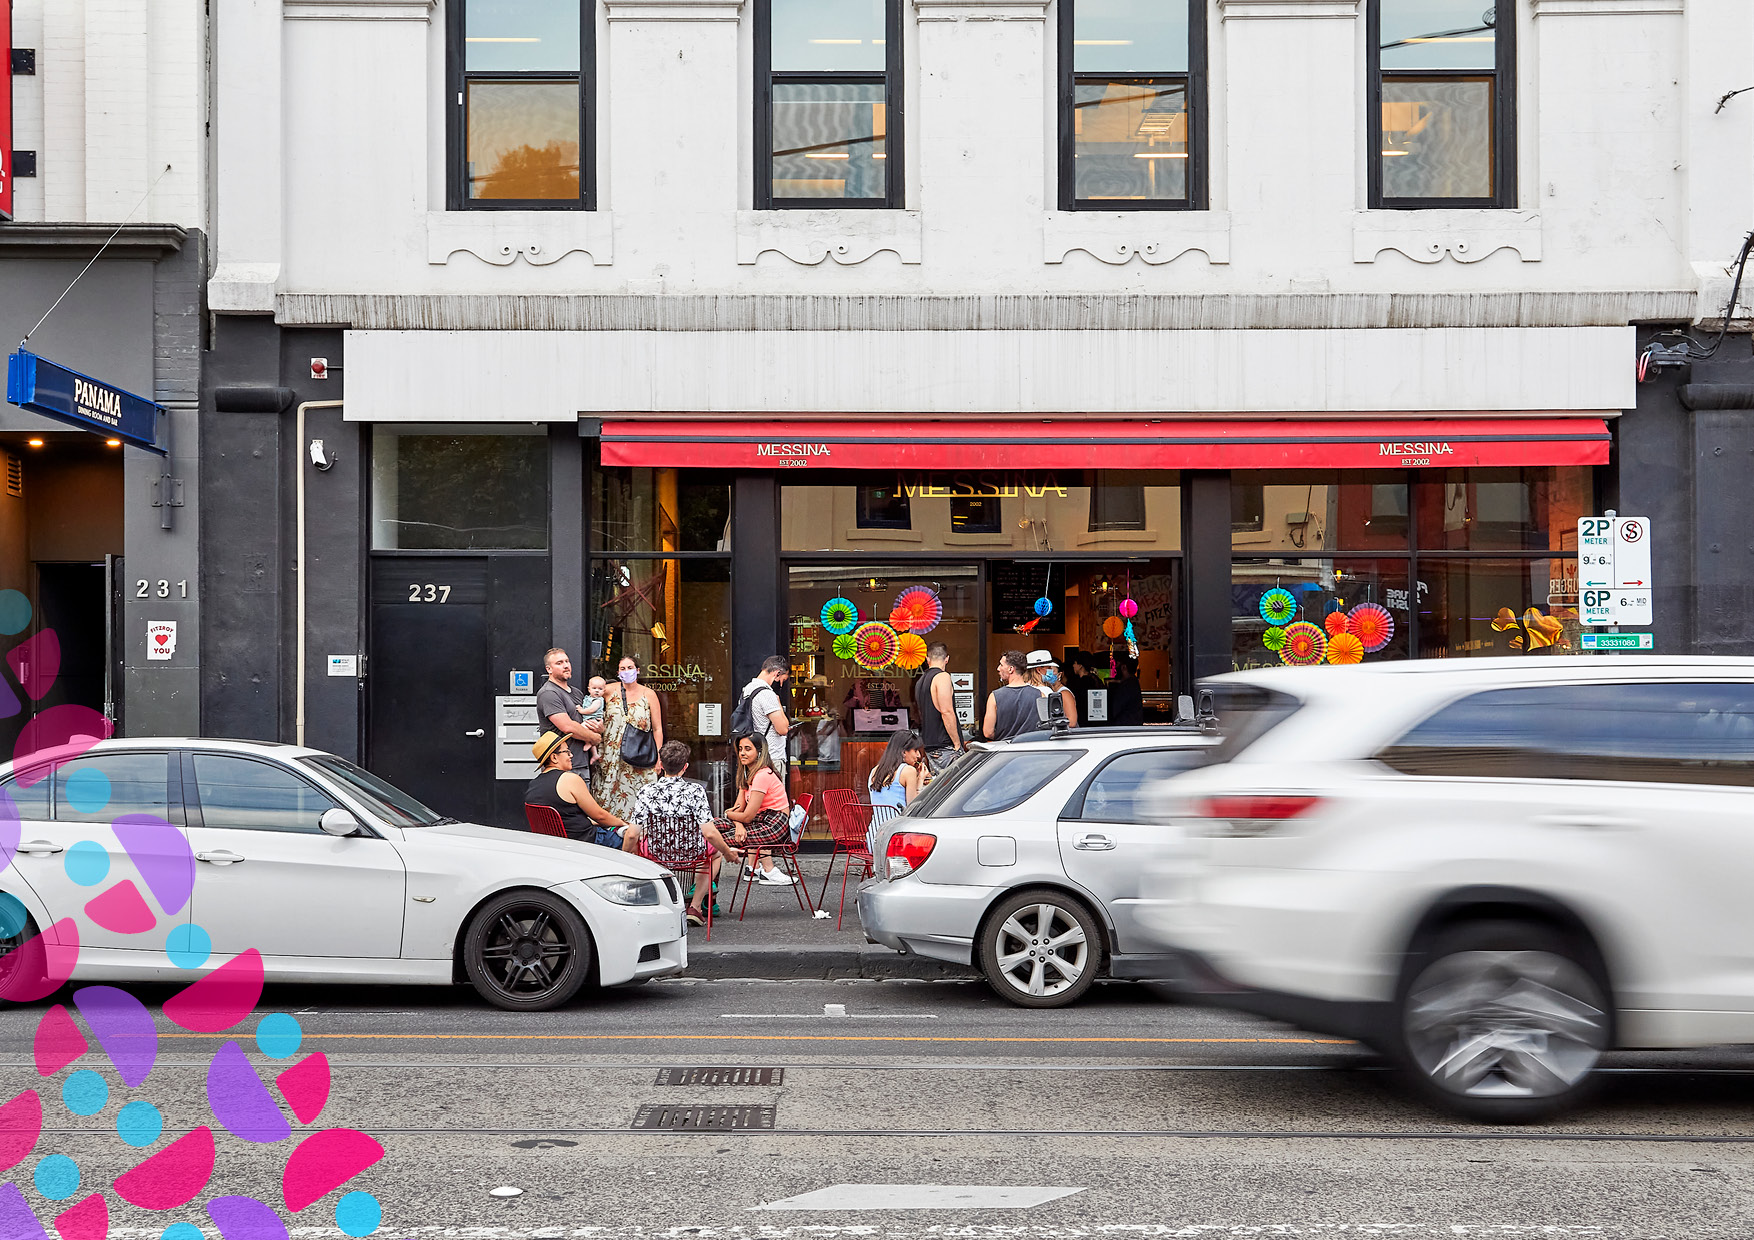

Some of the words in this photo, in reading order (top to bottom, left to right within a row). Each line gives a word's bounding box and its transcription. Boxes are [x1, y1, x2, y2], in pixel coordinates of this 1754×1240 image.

[74, 378, 122, 418] PANAMA
[757, 443, 831, 456] MESSINA
[1379, 442, 1453, 456] MESSINA
[790, 459, 808, 467] 2002
[1412, 458, 1430, 466] 2002
[892, 471, 1068, 498] MESSINA
[1582, 520, 1610, 536] 2P
[136, 579, 187, 598] 231
[408, 583, 451, 604] 237
[1583, 591, 1611, 607] 6P
[1586, 607, 1610, 615] METER
[150, 625, 174, 634] FITZROY
[153, 647, 171, 655] YOU
[640, 664, 705, 678] SSINA
[657, 683, 678, 691] 2002
[958, 710, 968, 718] 16
